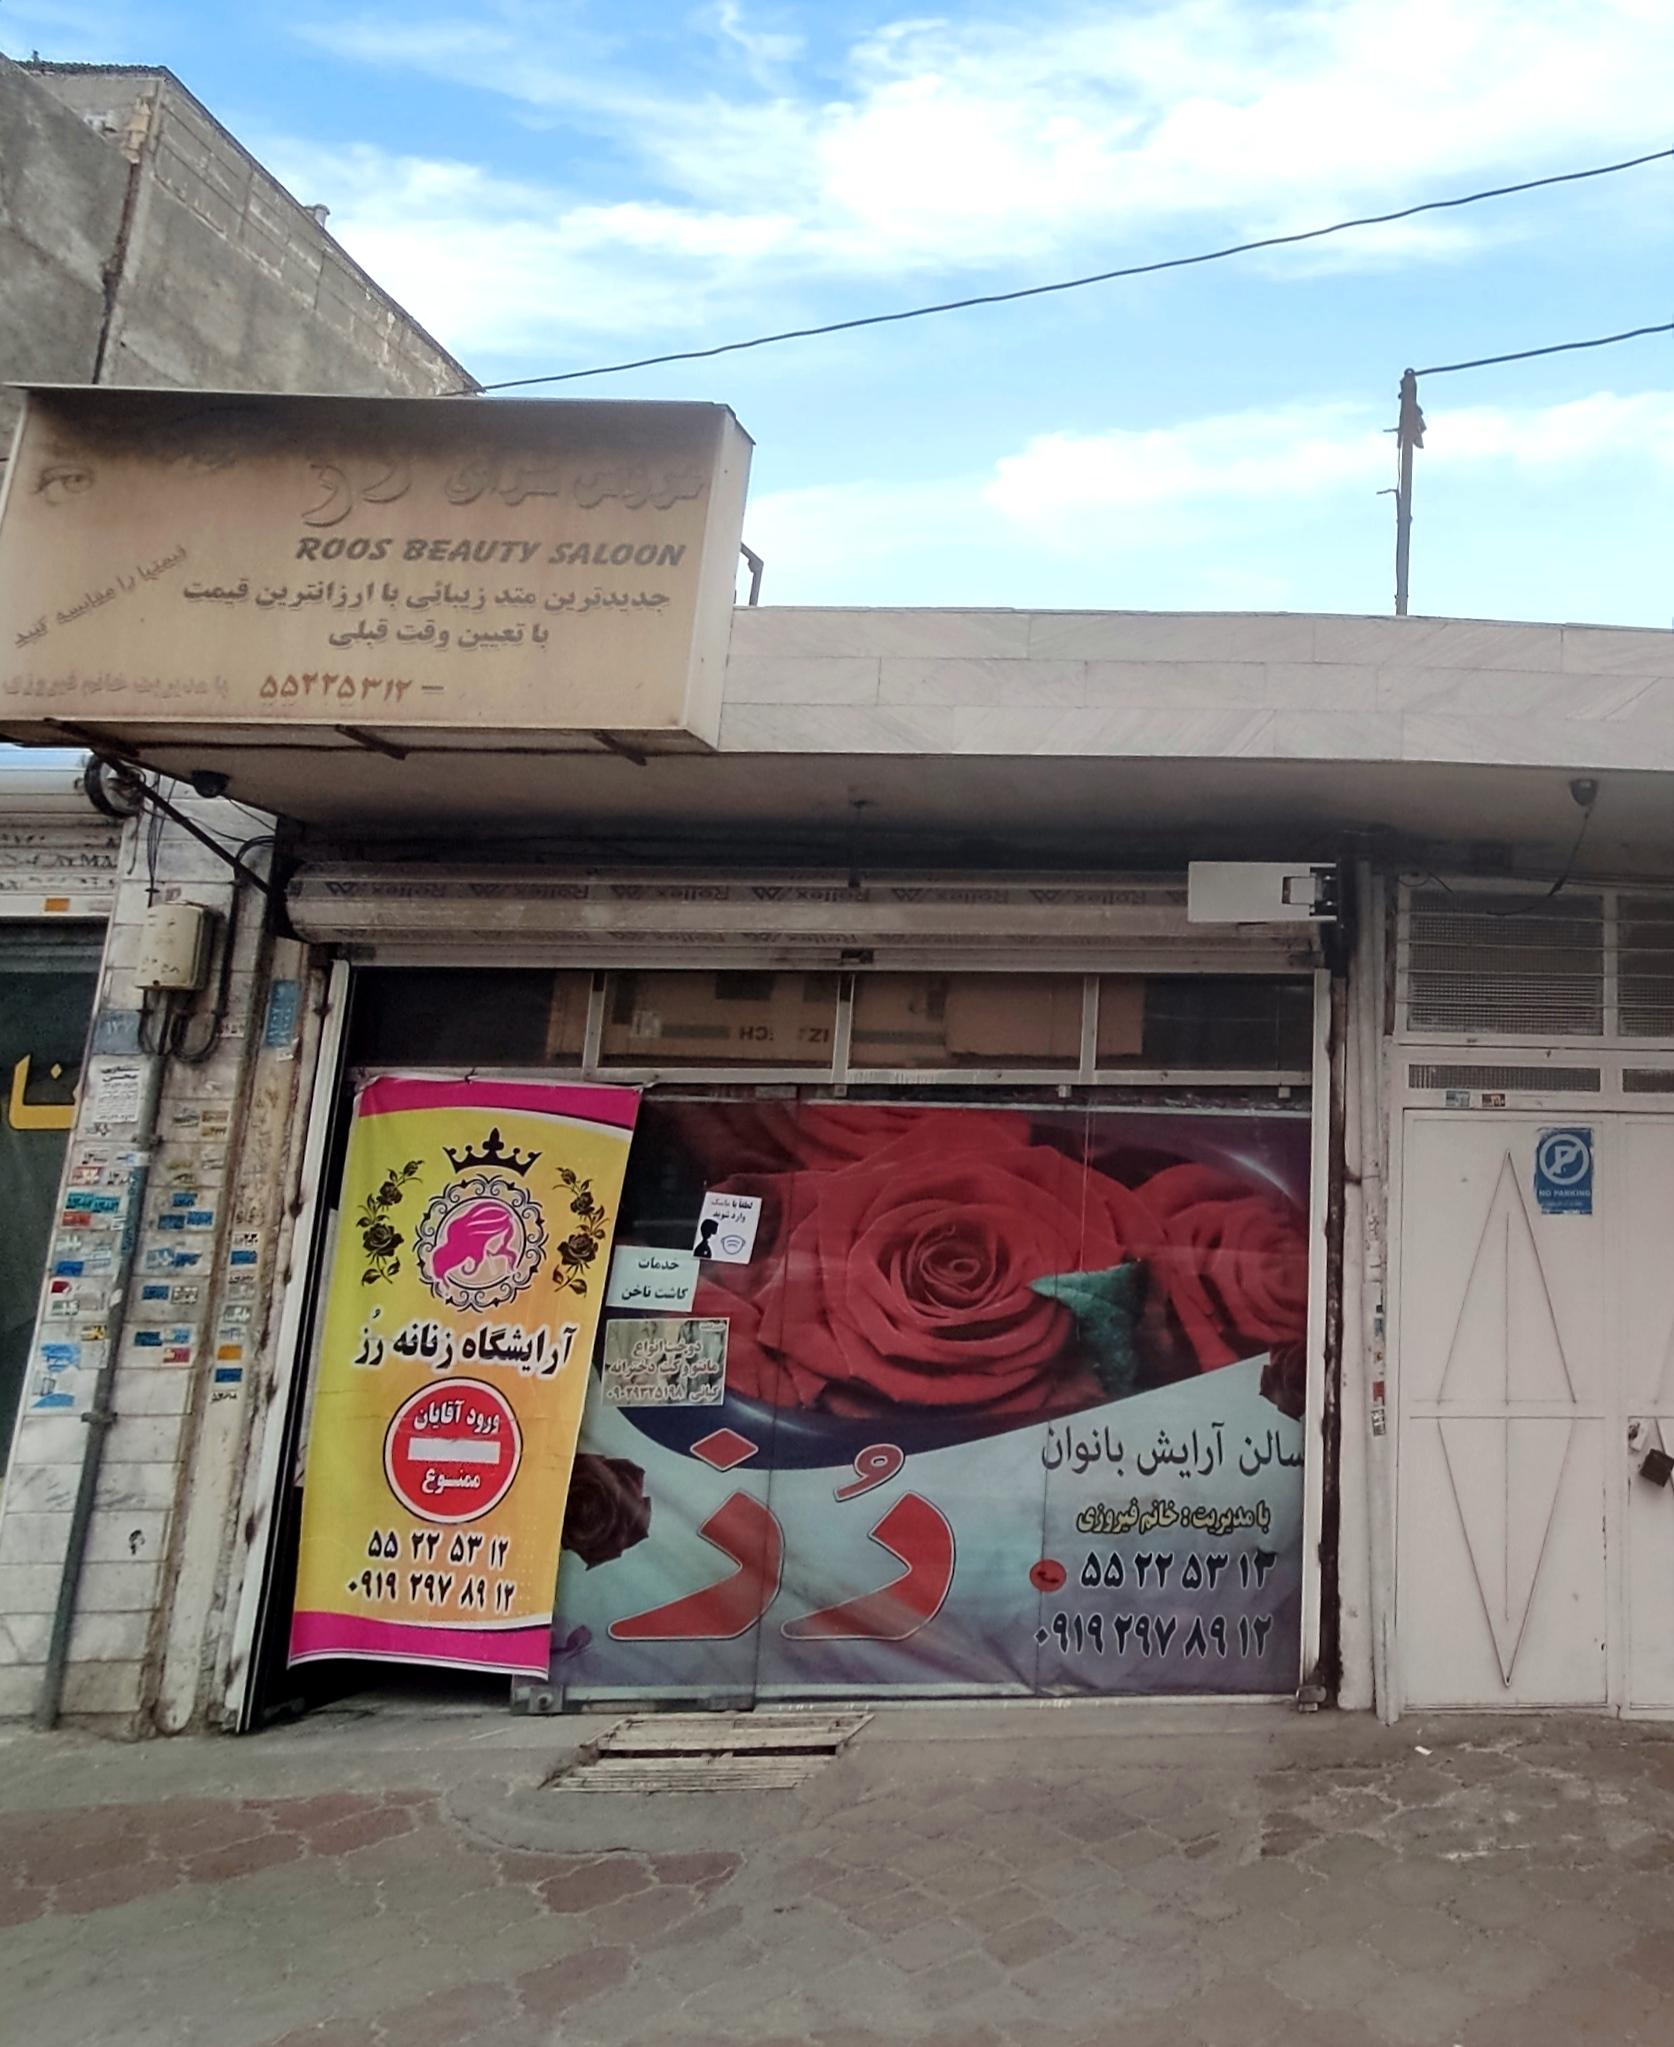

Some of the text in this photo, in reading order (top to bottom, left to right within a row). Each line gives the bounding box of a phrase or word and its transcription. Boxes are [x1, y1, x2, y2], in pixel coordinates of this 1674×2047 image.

[296, 537, 687, 566] ROOS BEAUTY SALOON
[183, 578, 249, 605] قیمت
[255, 580, 375, 608] ارزانترین
[382, 582, 399, 608] با
[494, 587, 537, 605] متد
[544, 586, 671, 613] جدیدترین
[329, 619, 549, 649] با تعیین وقت قبلی
[1553, 1189, 1592, 1198] PARKING
[638, 1255, 680, 1271] خدمات
[621, 1286, 689, 1301] کاشت ناخن
[392, 1322, 454, 1369] زنانه
[462, 1326, 578, 1375] آرایشگاه
[632, 1339, 664, 1357] انواع
[413, 1399, 500, 1434] ورود آقایان
[1041, 1422, 1305, 1478] سالن آرایش بانوان
[421, 1467, 481, 1494] ممنوع
[1077, 1497, 1140, 1536] فیروزی
[1140, 1499, 1180, 1535] خانم
[1257, 1499, 1271, 1535] با
[368, 1530, 508, 1568] ۵۵ ۲۲ ۵۳ ۱۲
[1081, 1549, 1277, 1590] ۵۵ ۲۲ ۵۳ ۱۲
[348, 1570, 515, 1612] ۰۹۱۹ ۲۹۷ ۸۹ ۱۲
[1034, 1612, 1273, 1657] ۰۹۱۹ ۲۹۷ ۸۹ ۱۲
